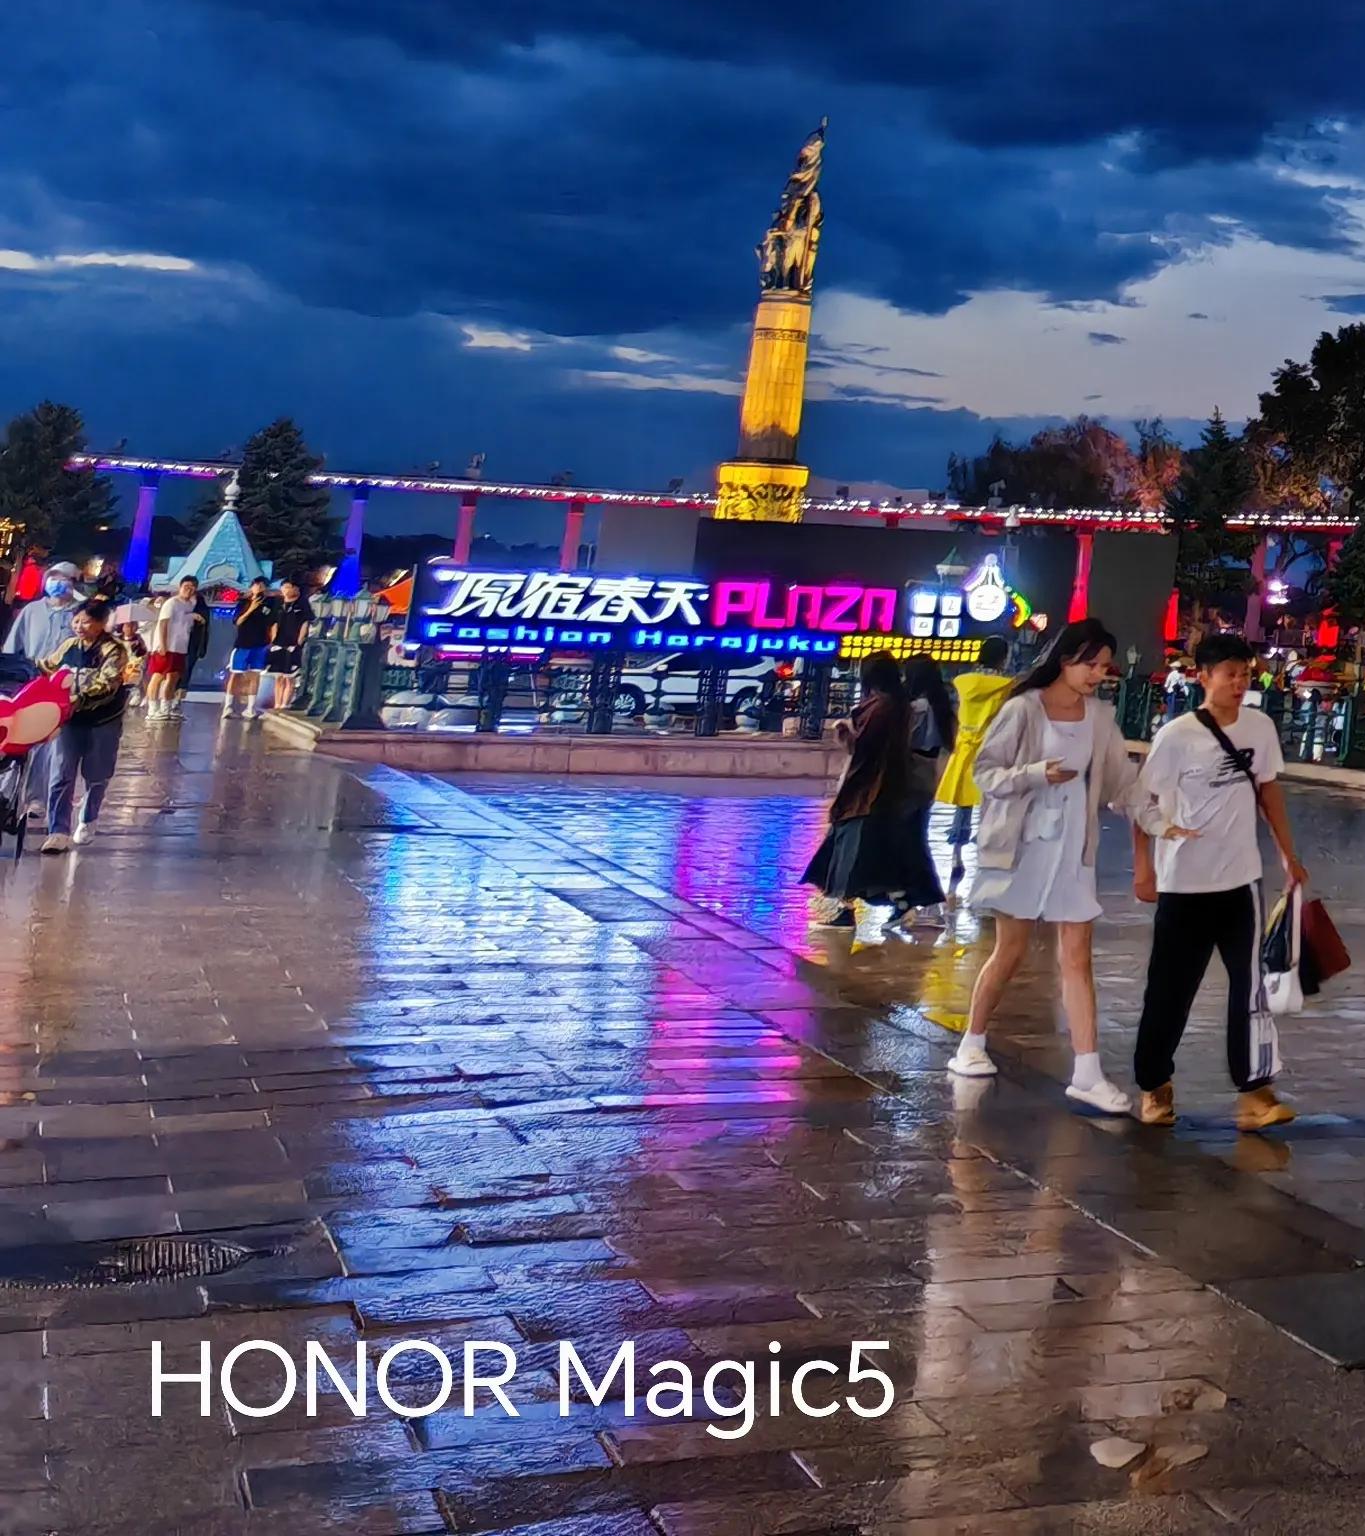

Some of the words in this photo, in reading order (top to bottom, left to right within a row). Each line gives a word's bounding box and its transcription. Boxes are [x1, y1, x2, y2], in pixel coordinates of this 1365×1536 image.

[713, 581, 898, 633] PLAZA
[427, 620, 612, 644] Fashion
[635, 629, 836, 653] Harajuku
